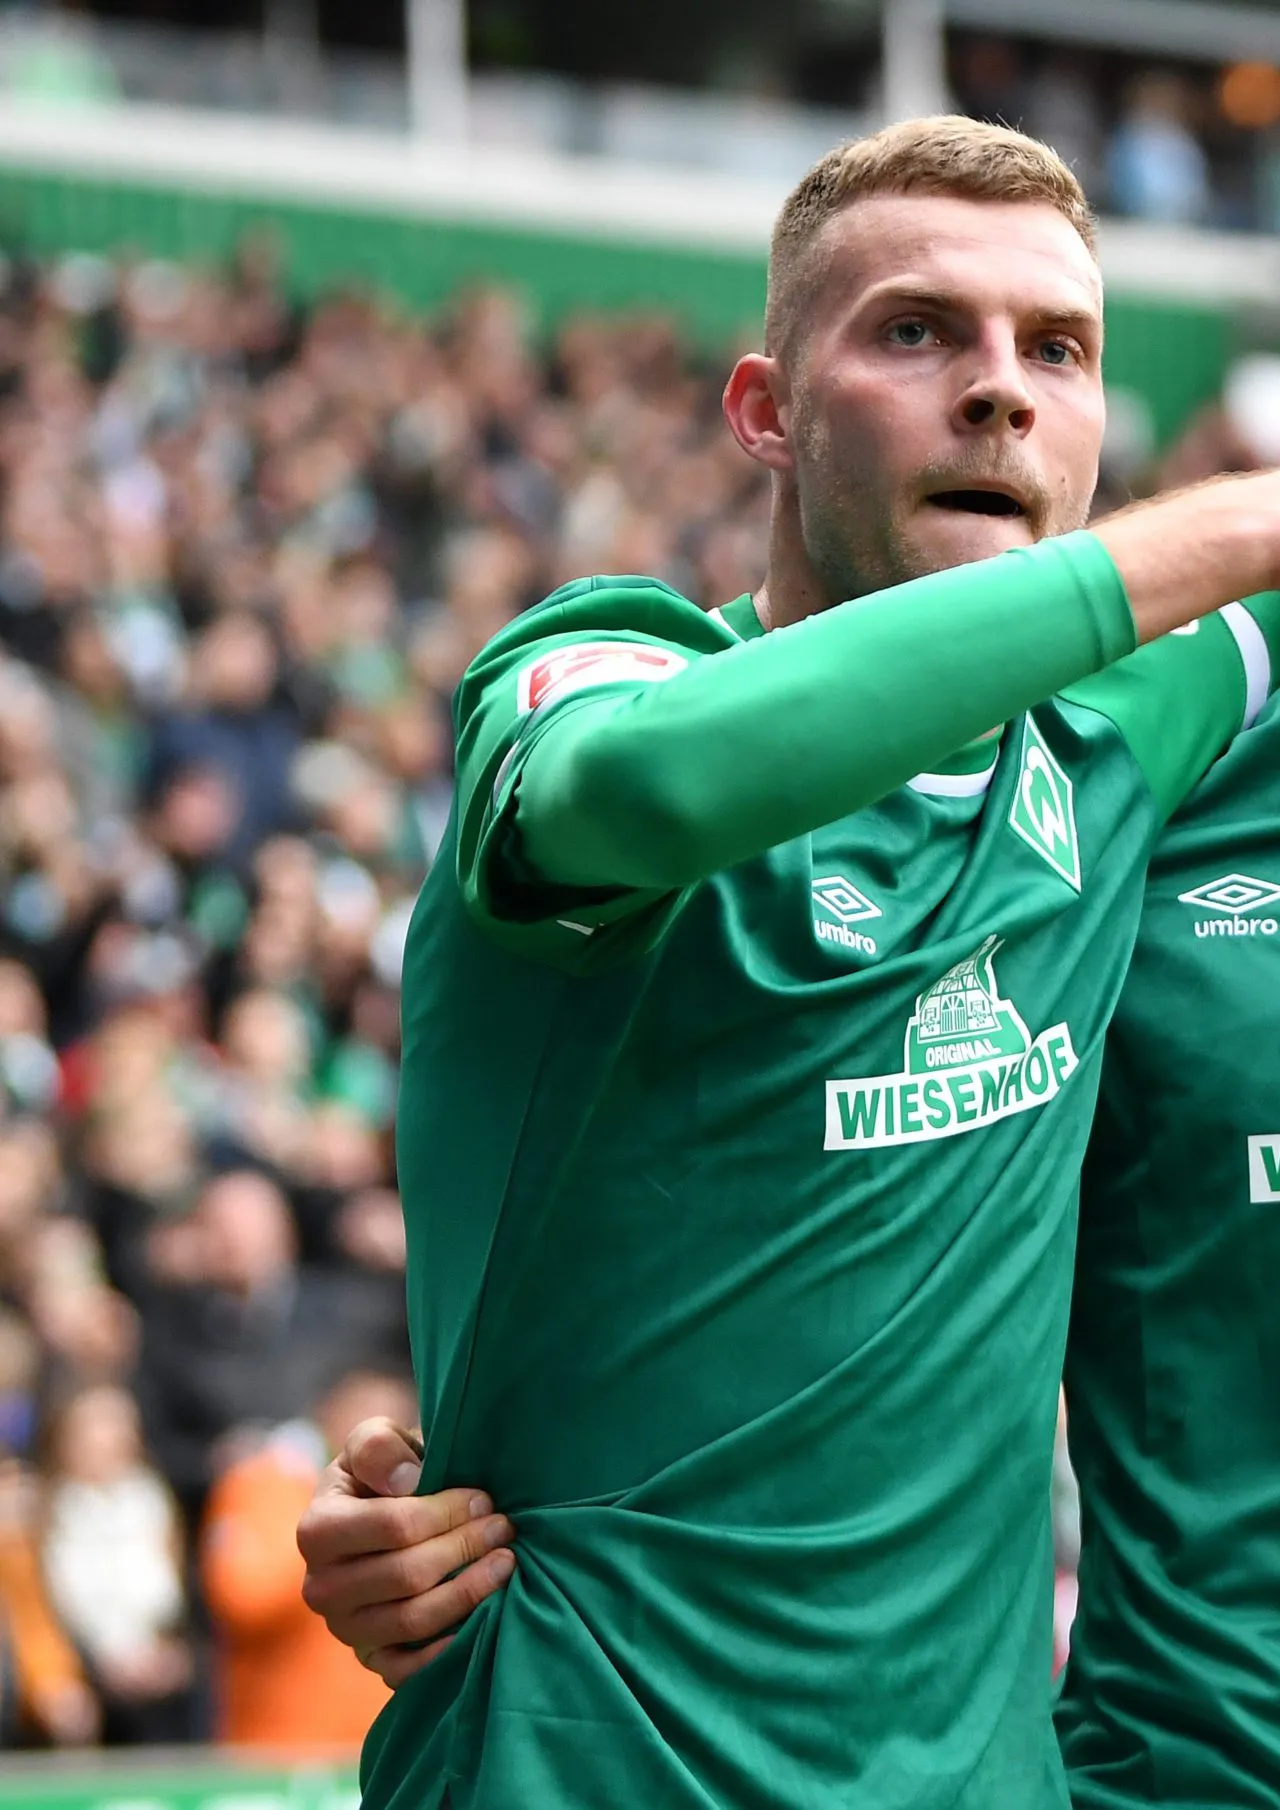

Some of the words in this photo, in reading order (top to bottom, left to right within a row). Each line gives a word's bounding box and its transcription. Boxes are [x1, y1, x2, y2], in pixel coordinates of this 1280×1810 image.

[815, 919, 876, 954] umbro
[1194, 916, 1278, 938] umbro
[925, 1038, 1001, 1067] ORIGINAL
[836, 1036, 1072, 1140] WIESENHOF
